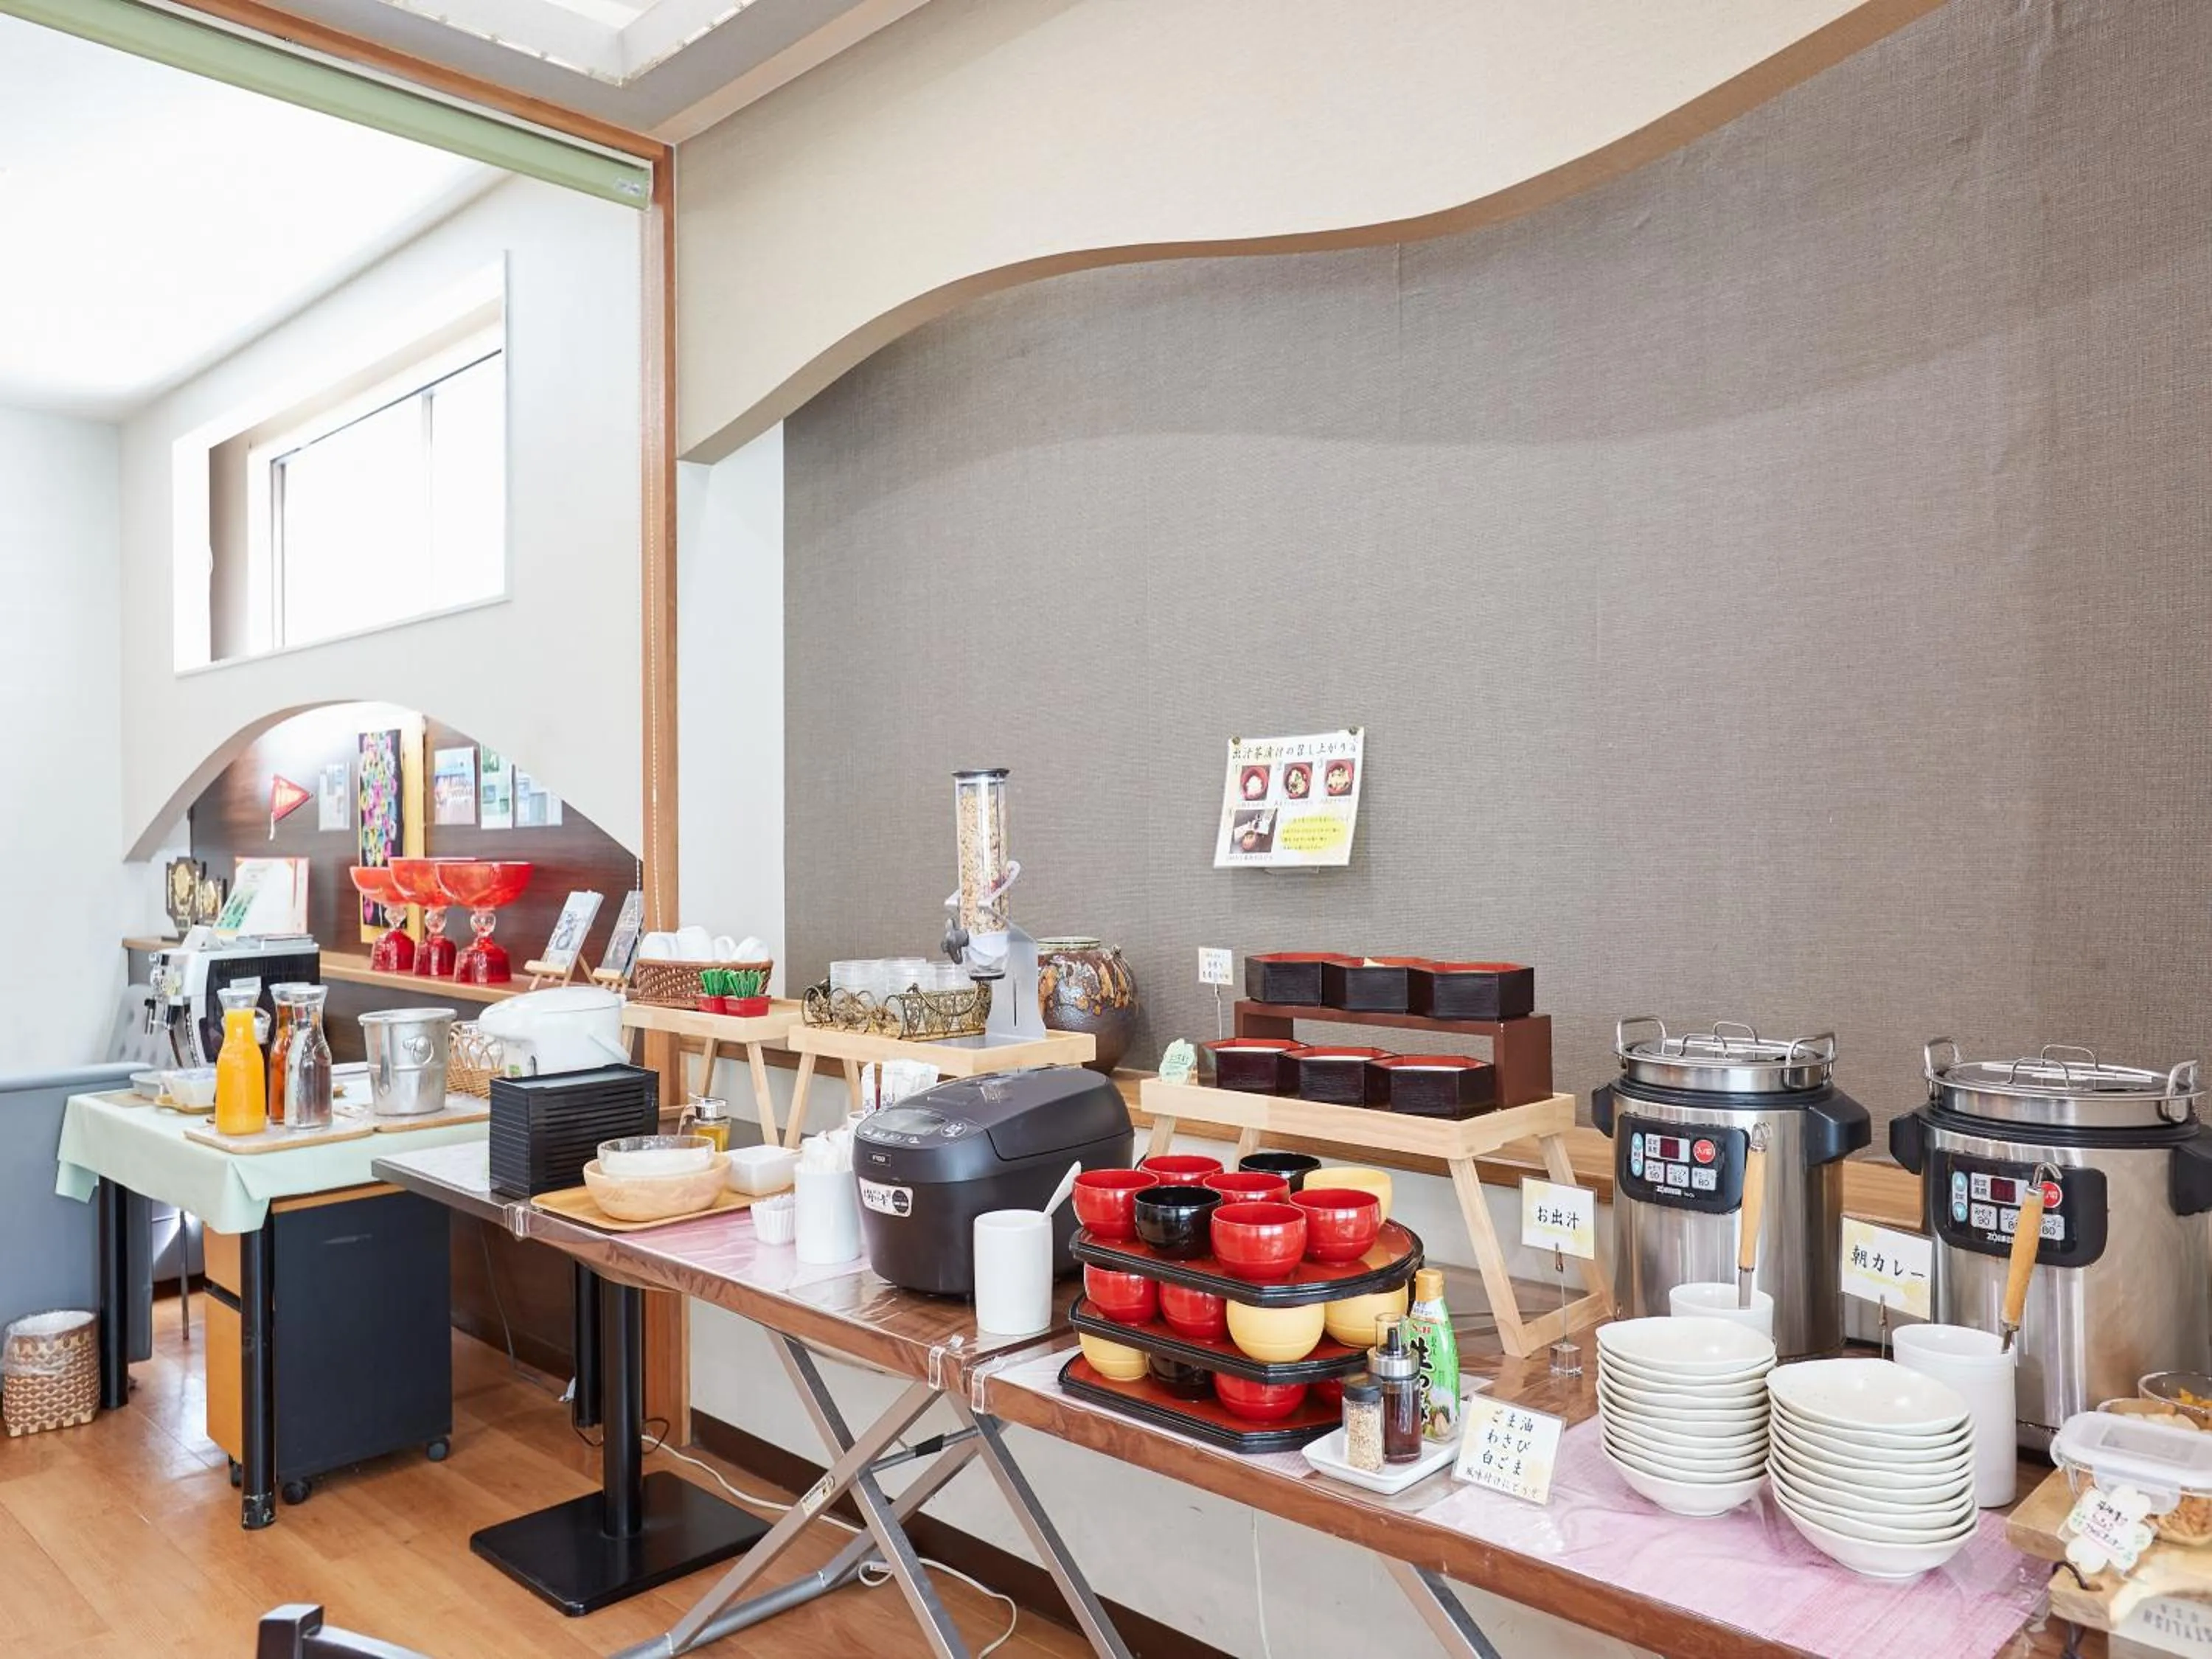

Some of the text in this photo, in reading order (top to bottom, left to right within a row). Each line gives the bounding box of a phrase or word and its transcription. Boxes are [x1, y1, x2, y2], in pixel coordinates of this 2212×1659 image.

[1537, 1205, 1579, 1231] お出汁
[1851, 1244, 1926, 1279] 朝カレー
[1492, 1410, 1534, 1433] ごま油
[1487, 1429, 1531, 1453] わさび
[1483, 1450, 1522, 1475] 白ごま
